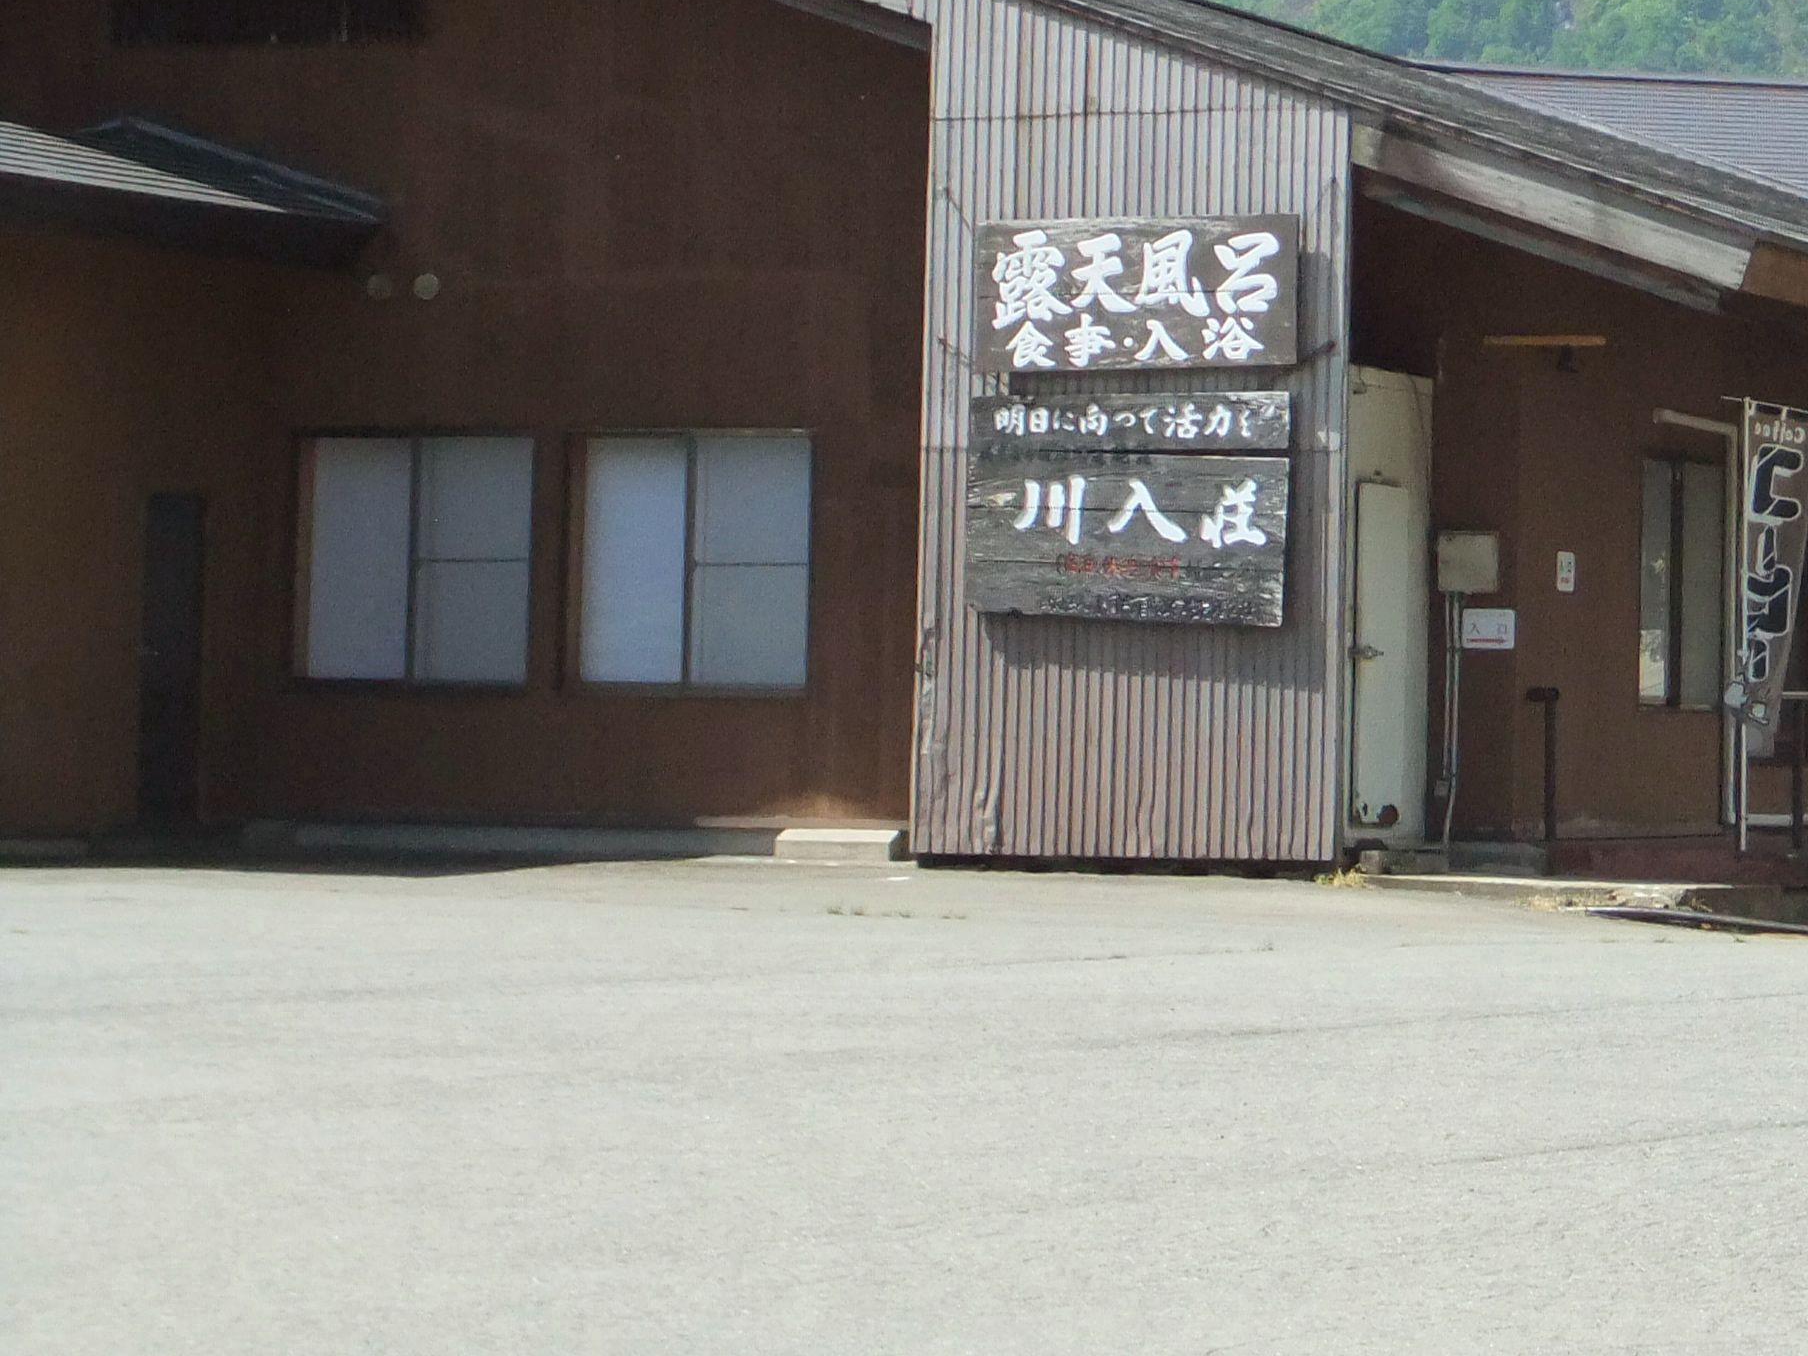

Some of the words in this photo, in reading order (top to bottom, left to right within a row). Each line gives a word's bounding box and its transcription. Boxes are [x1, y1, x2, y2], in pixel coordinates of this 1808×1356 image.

[993, 230, 1280, 330] 露天風呂
[1006, 315, 1264, 367] 食事・入浴
[1014, 475, 1267, 548] 川入荘
